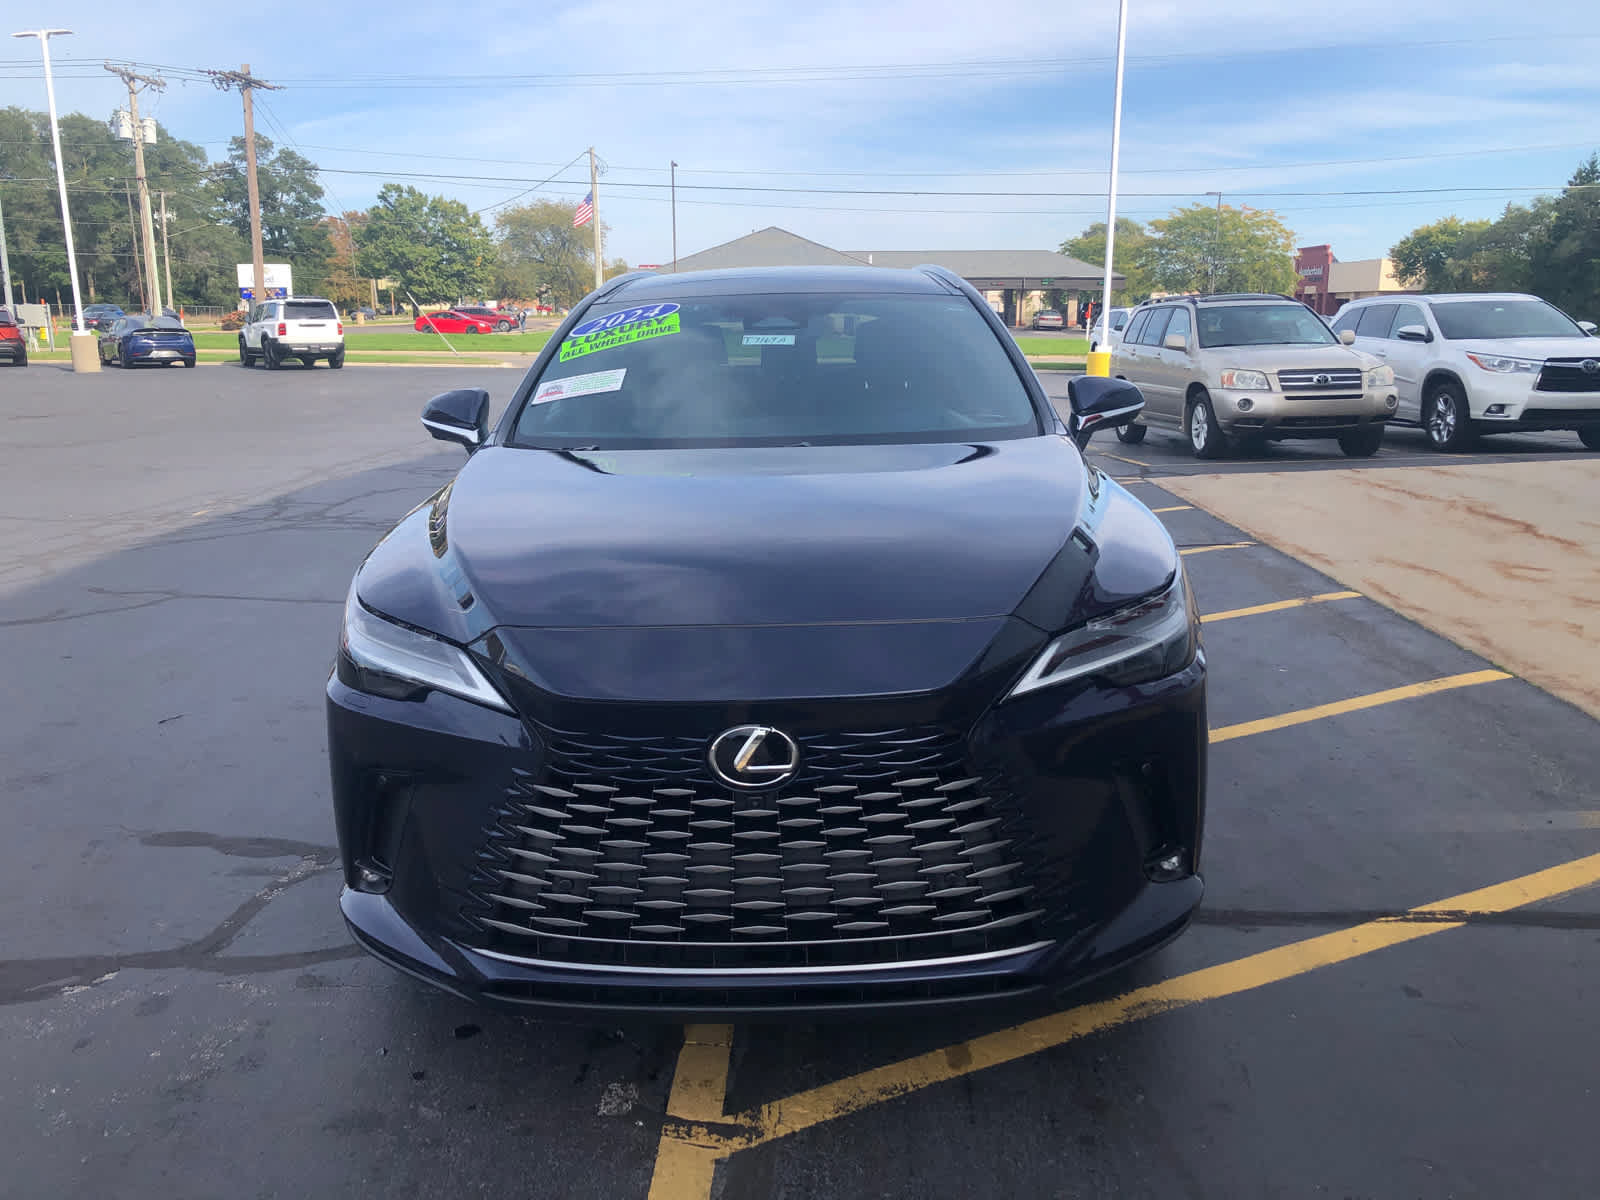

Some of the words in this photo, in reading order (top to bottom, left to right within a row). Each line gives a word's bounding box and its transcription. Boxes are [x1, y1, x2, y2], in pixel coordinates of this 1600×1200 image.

[570, 316, 667, 348] LUXURY
[589, 304, 665, 332] 2024
[561, 348, 585, 360] ALL
[589, 336, 631, 351] WHEEL
[636, 323, 678, 339] DRIVE
